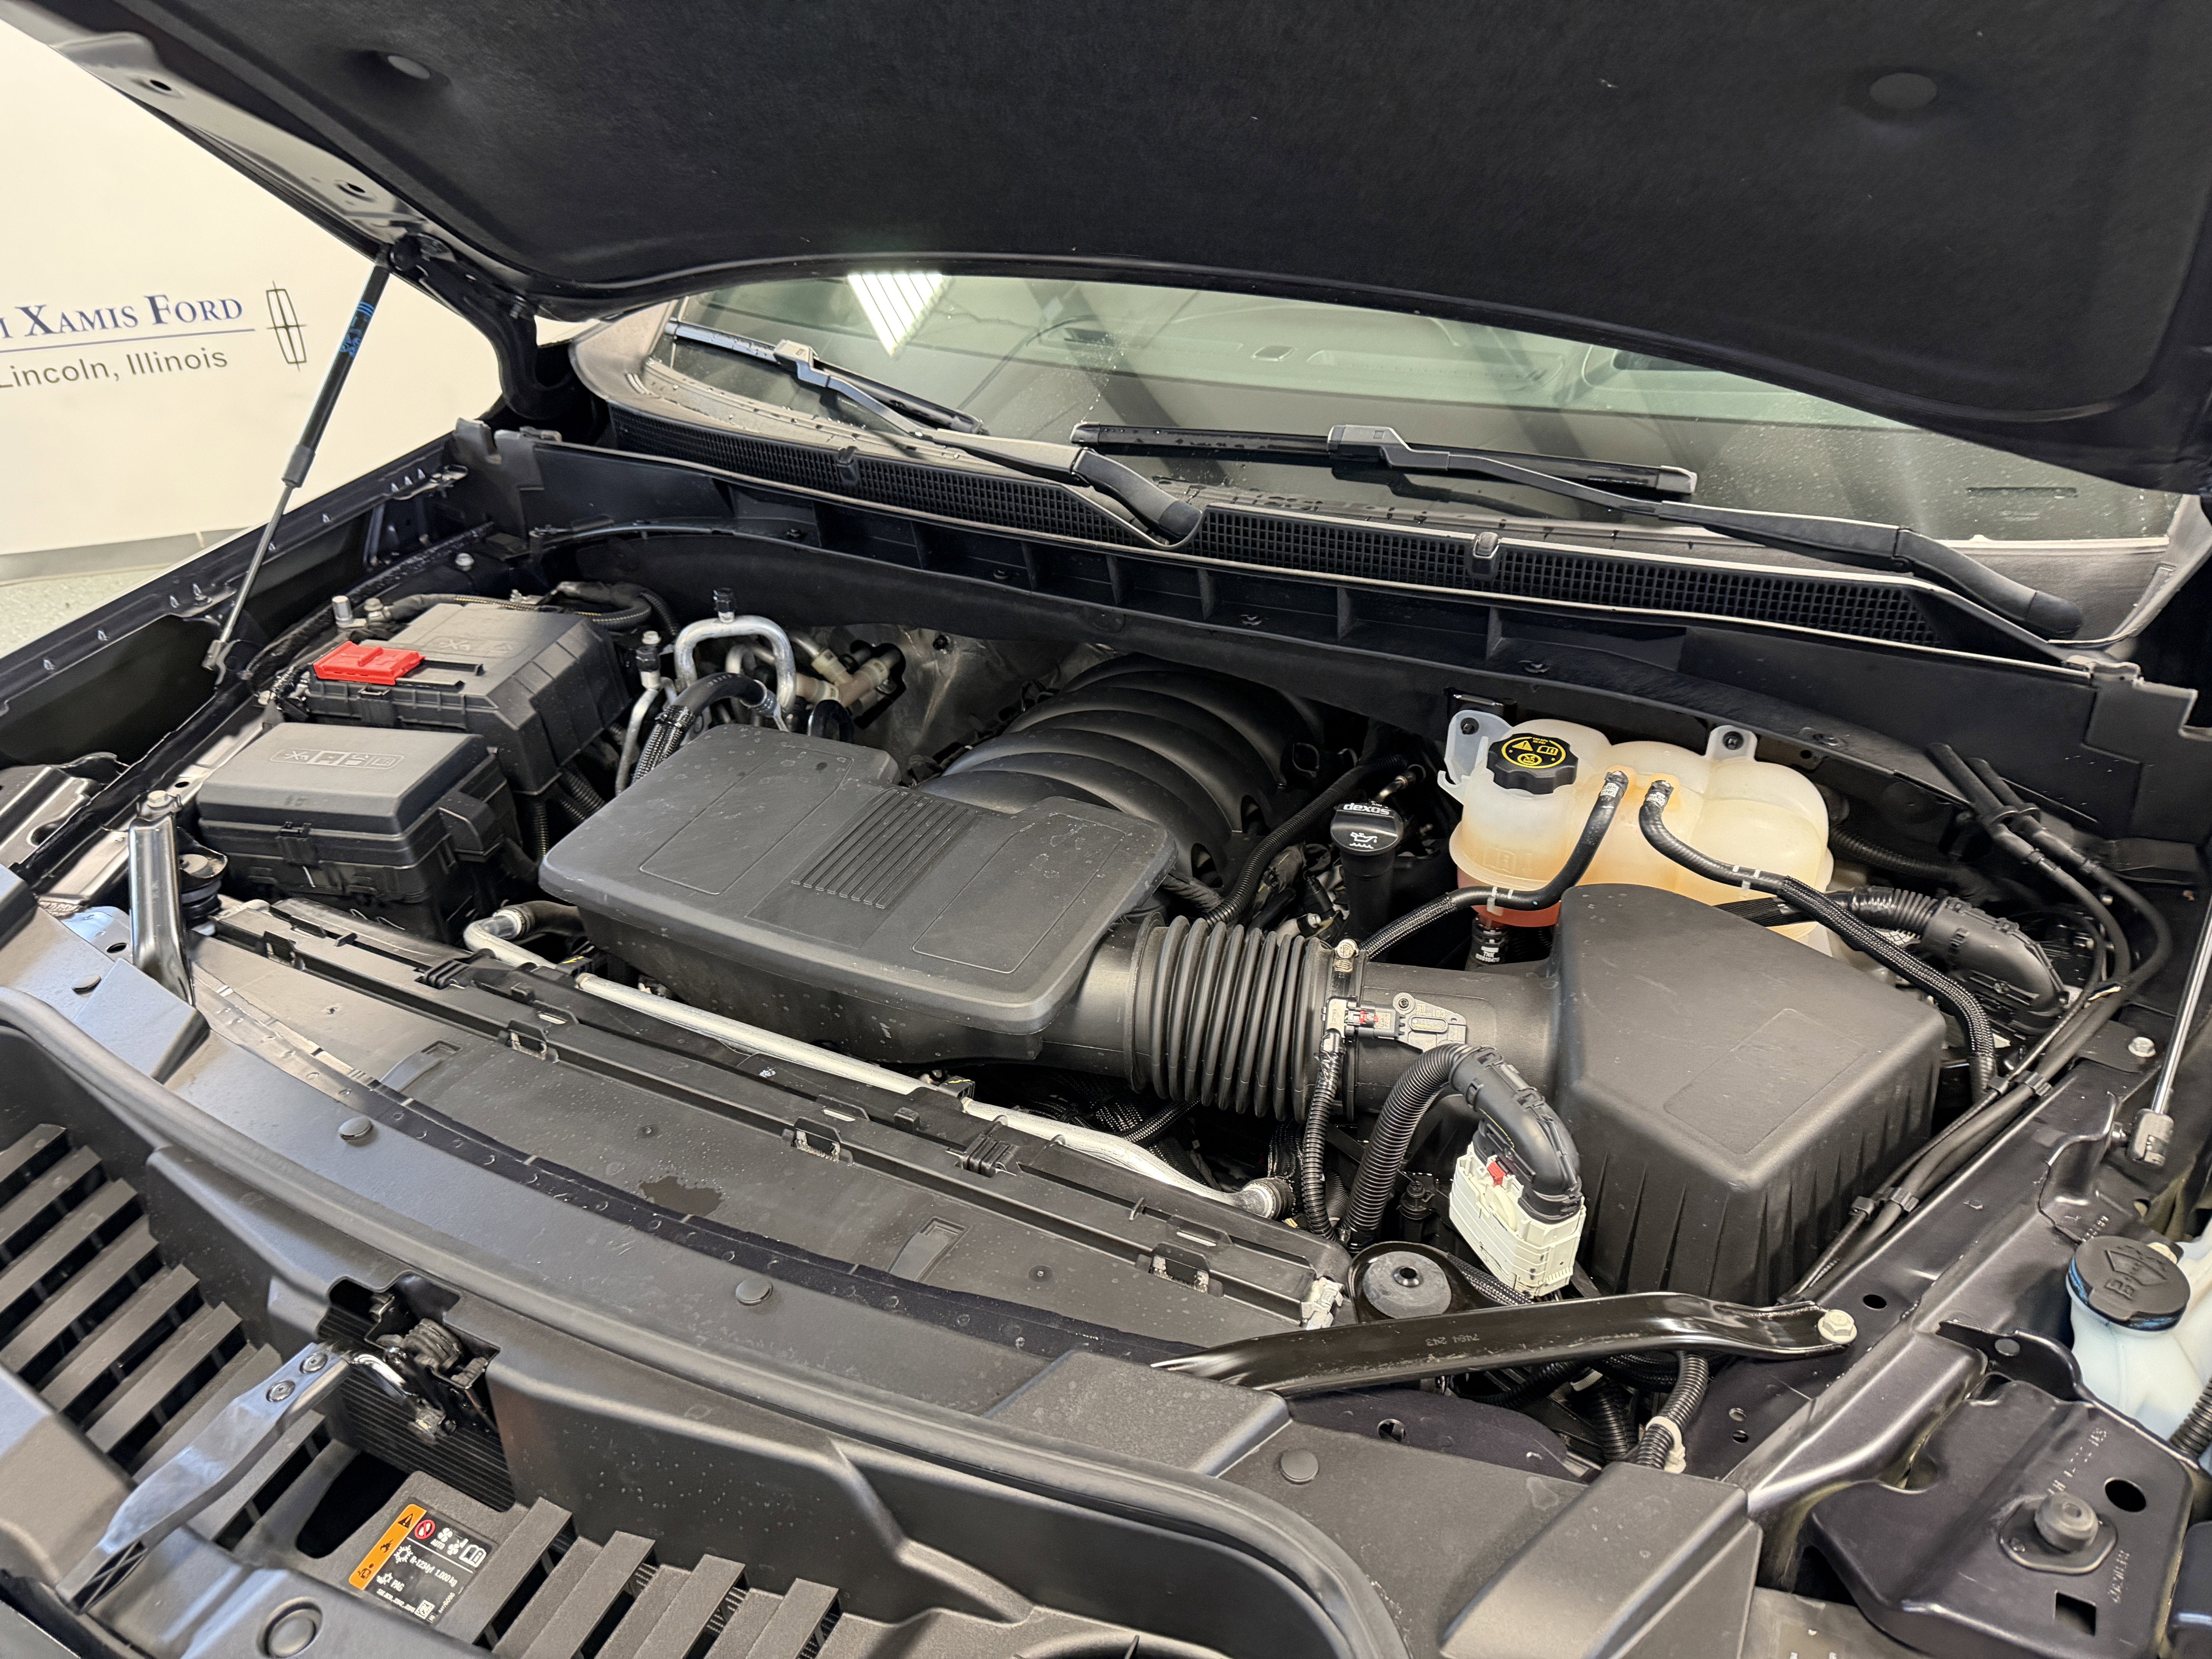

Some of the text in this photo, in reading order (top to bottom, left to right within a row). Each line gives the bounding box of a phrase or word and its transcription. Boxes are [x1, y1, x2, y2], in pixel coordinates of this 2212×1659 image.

[126, 347, 228, 375] Illinois
[1343, 803, 1392, 815] dexos
[430, 1539, 445, 1550] AUTO
[409, 1556, 436, 1574] R-1234yf
[449, 1576, 458, 1587] kg
[390, 1579, 405, 1592] PAG
